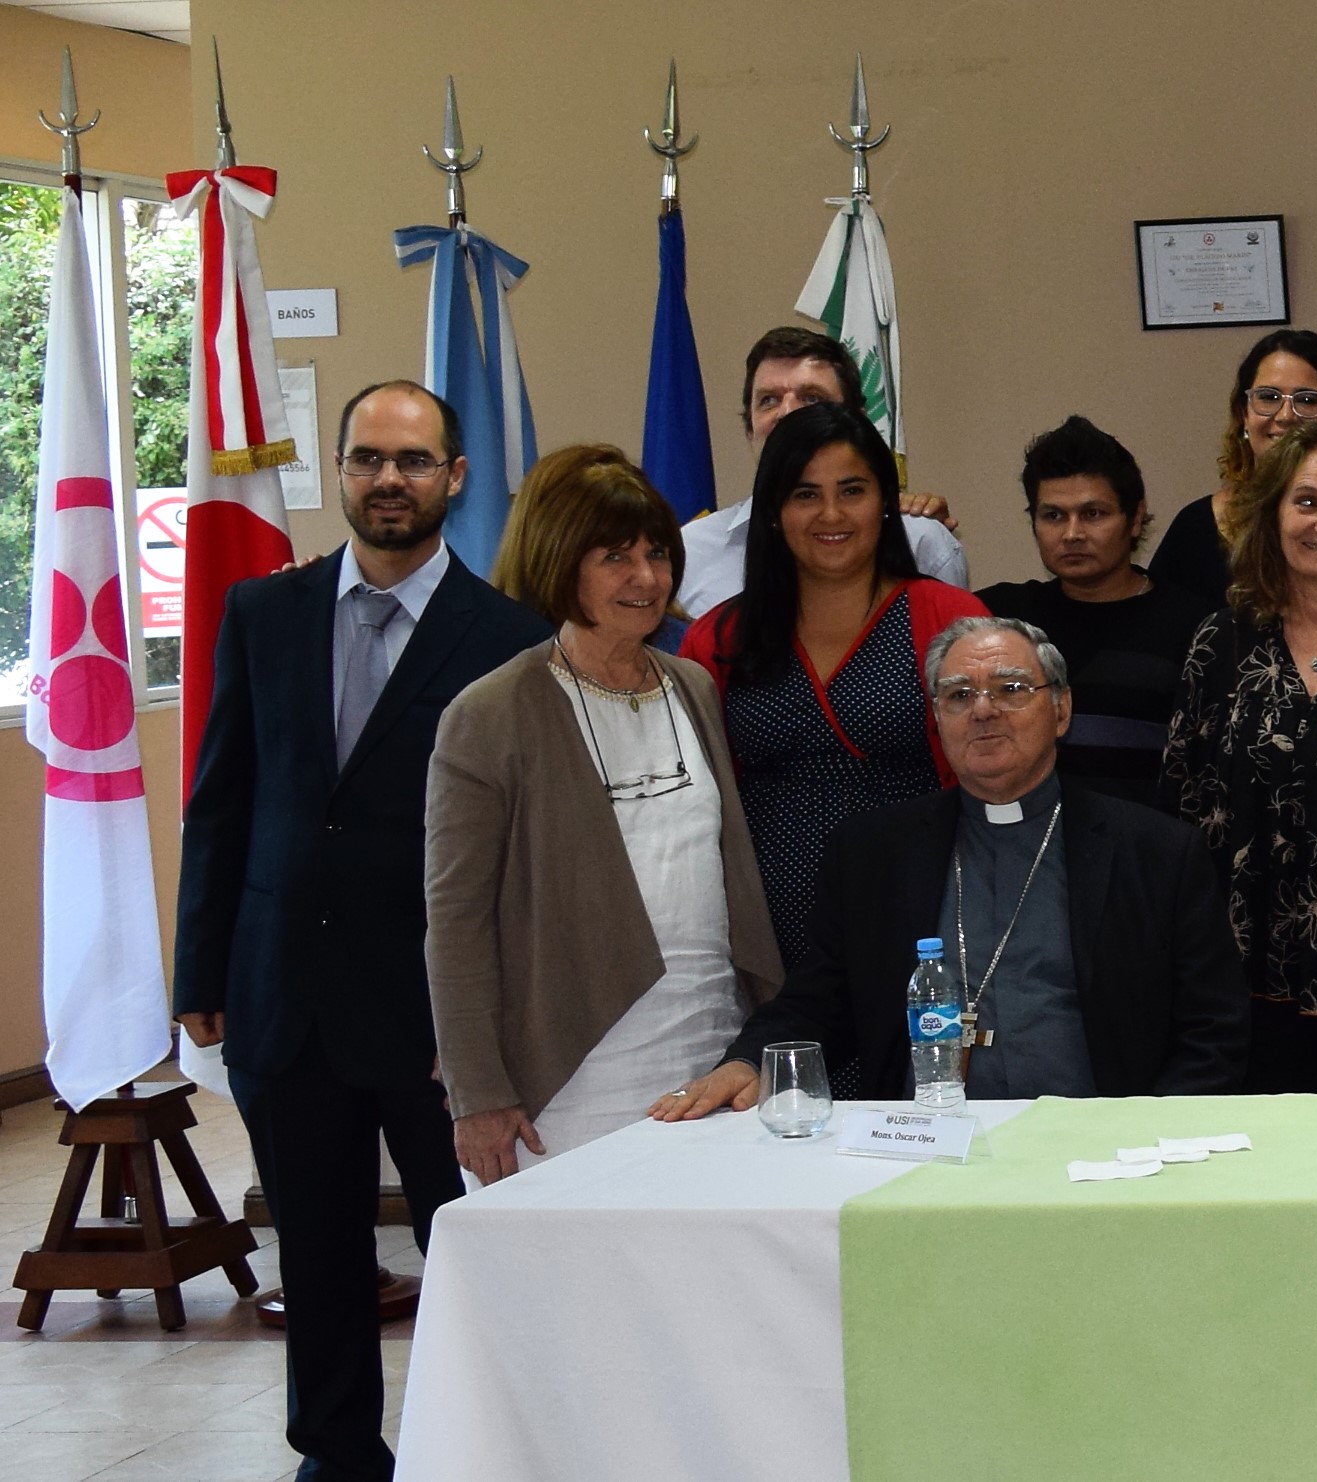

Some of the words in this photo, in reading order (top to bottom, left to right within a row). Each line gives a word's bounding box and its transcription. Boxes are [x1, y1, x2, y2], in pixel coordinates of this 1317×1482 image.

[278, 307, 316, 320] BAÑOS
[923, 1016, 939, 1024] bon
[921, 1022, 942, 1030] aqua
[894, 1116, 910, 1125] USI
[870, 1130, 893, 1140] Mons.
[894, 1132, 916, 1142] Oscar
[918, 1133, 936, 1144] Ojea
